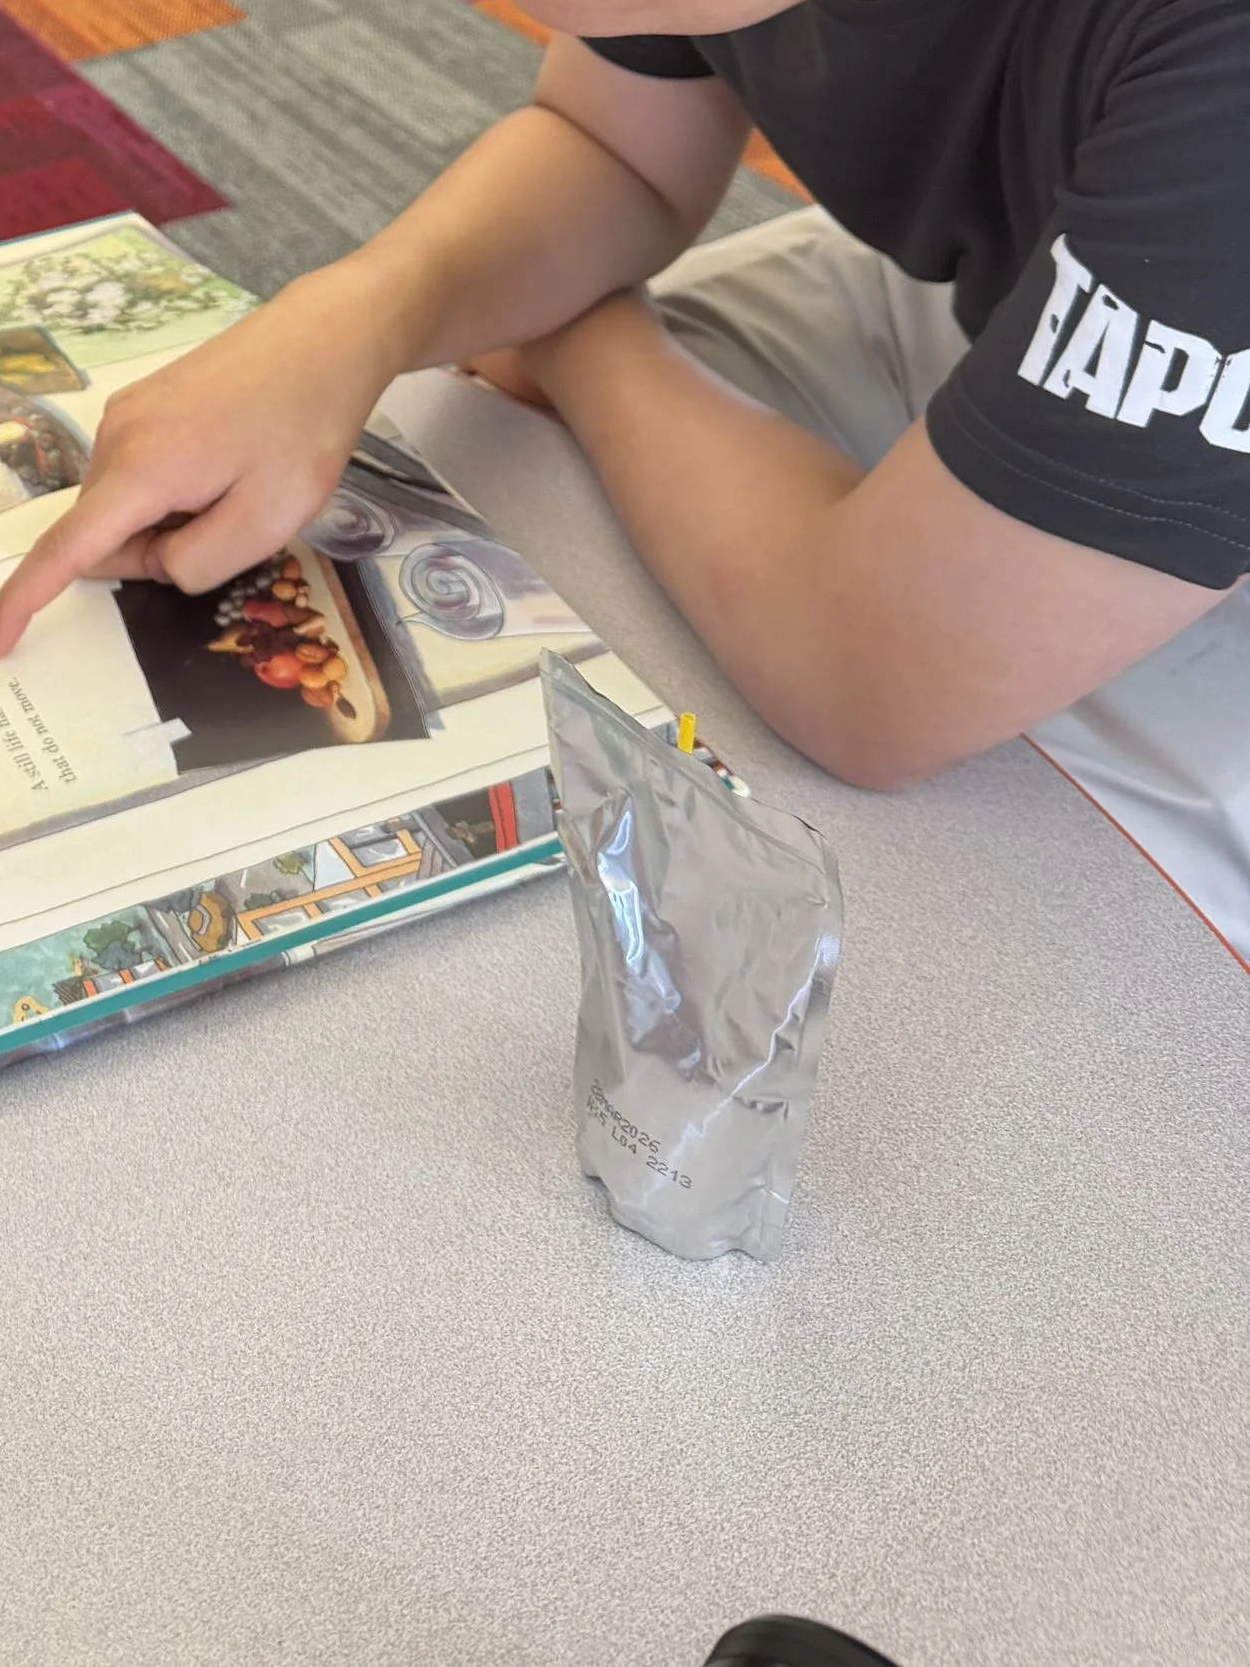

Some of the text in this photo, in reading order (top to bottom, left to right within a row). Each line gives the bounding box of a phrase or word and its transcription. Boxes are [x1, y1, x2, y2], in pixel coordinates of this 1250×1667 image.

[2, 730, 24, 752] life
[8, 677, 78, 783] that do not move.
[13, 751, 41, 778] still
[31, 780, 49, 792] A
[646, 1155, 692, 1189] 2213
